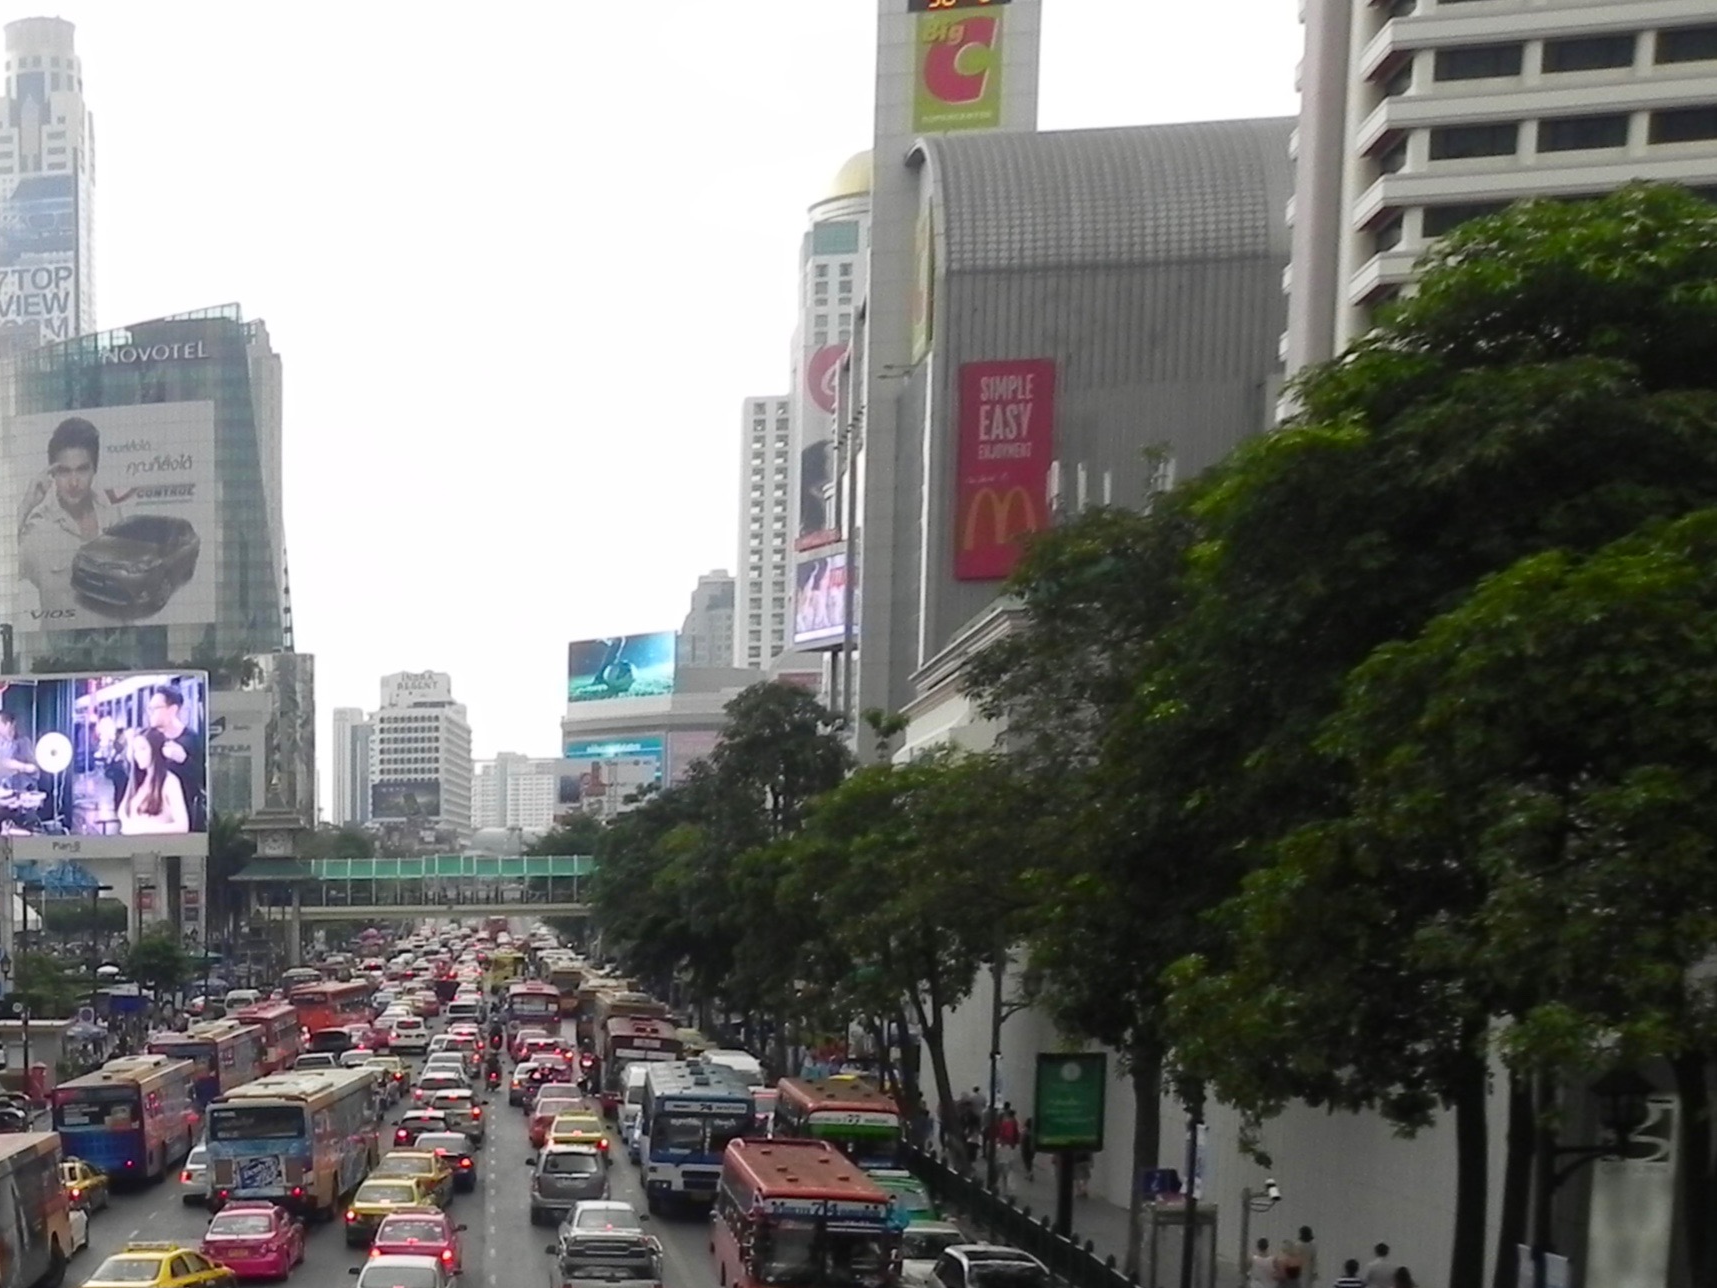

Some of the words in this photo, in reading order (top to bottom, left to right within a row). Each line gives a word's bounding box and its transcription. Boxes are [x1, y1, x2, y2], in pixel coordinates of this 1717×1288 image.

[101, 339, 210, 364] NOVOTEL
[980, 373, 1035, 401] SIMPLE
[979, 402, 1033, 441] EASY
[31, 609, 76, 620] VIOS
